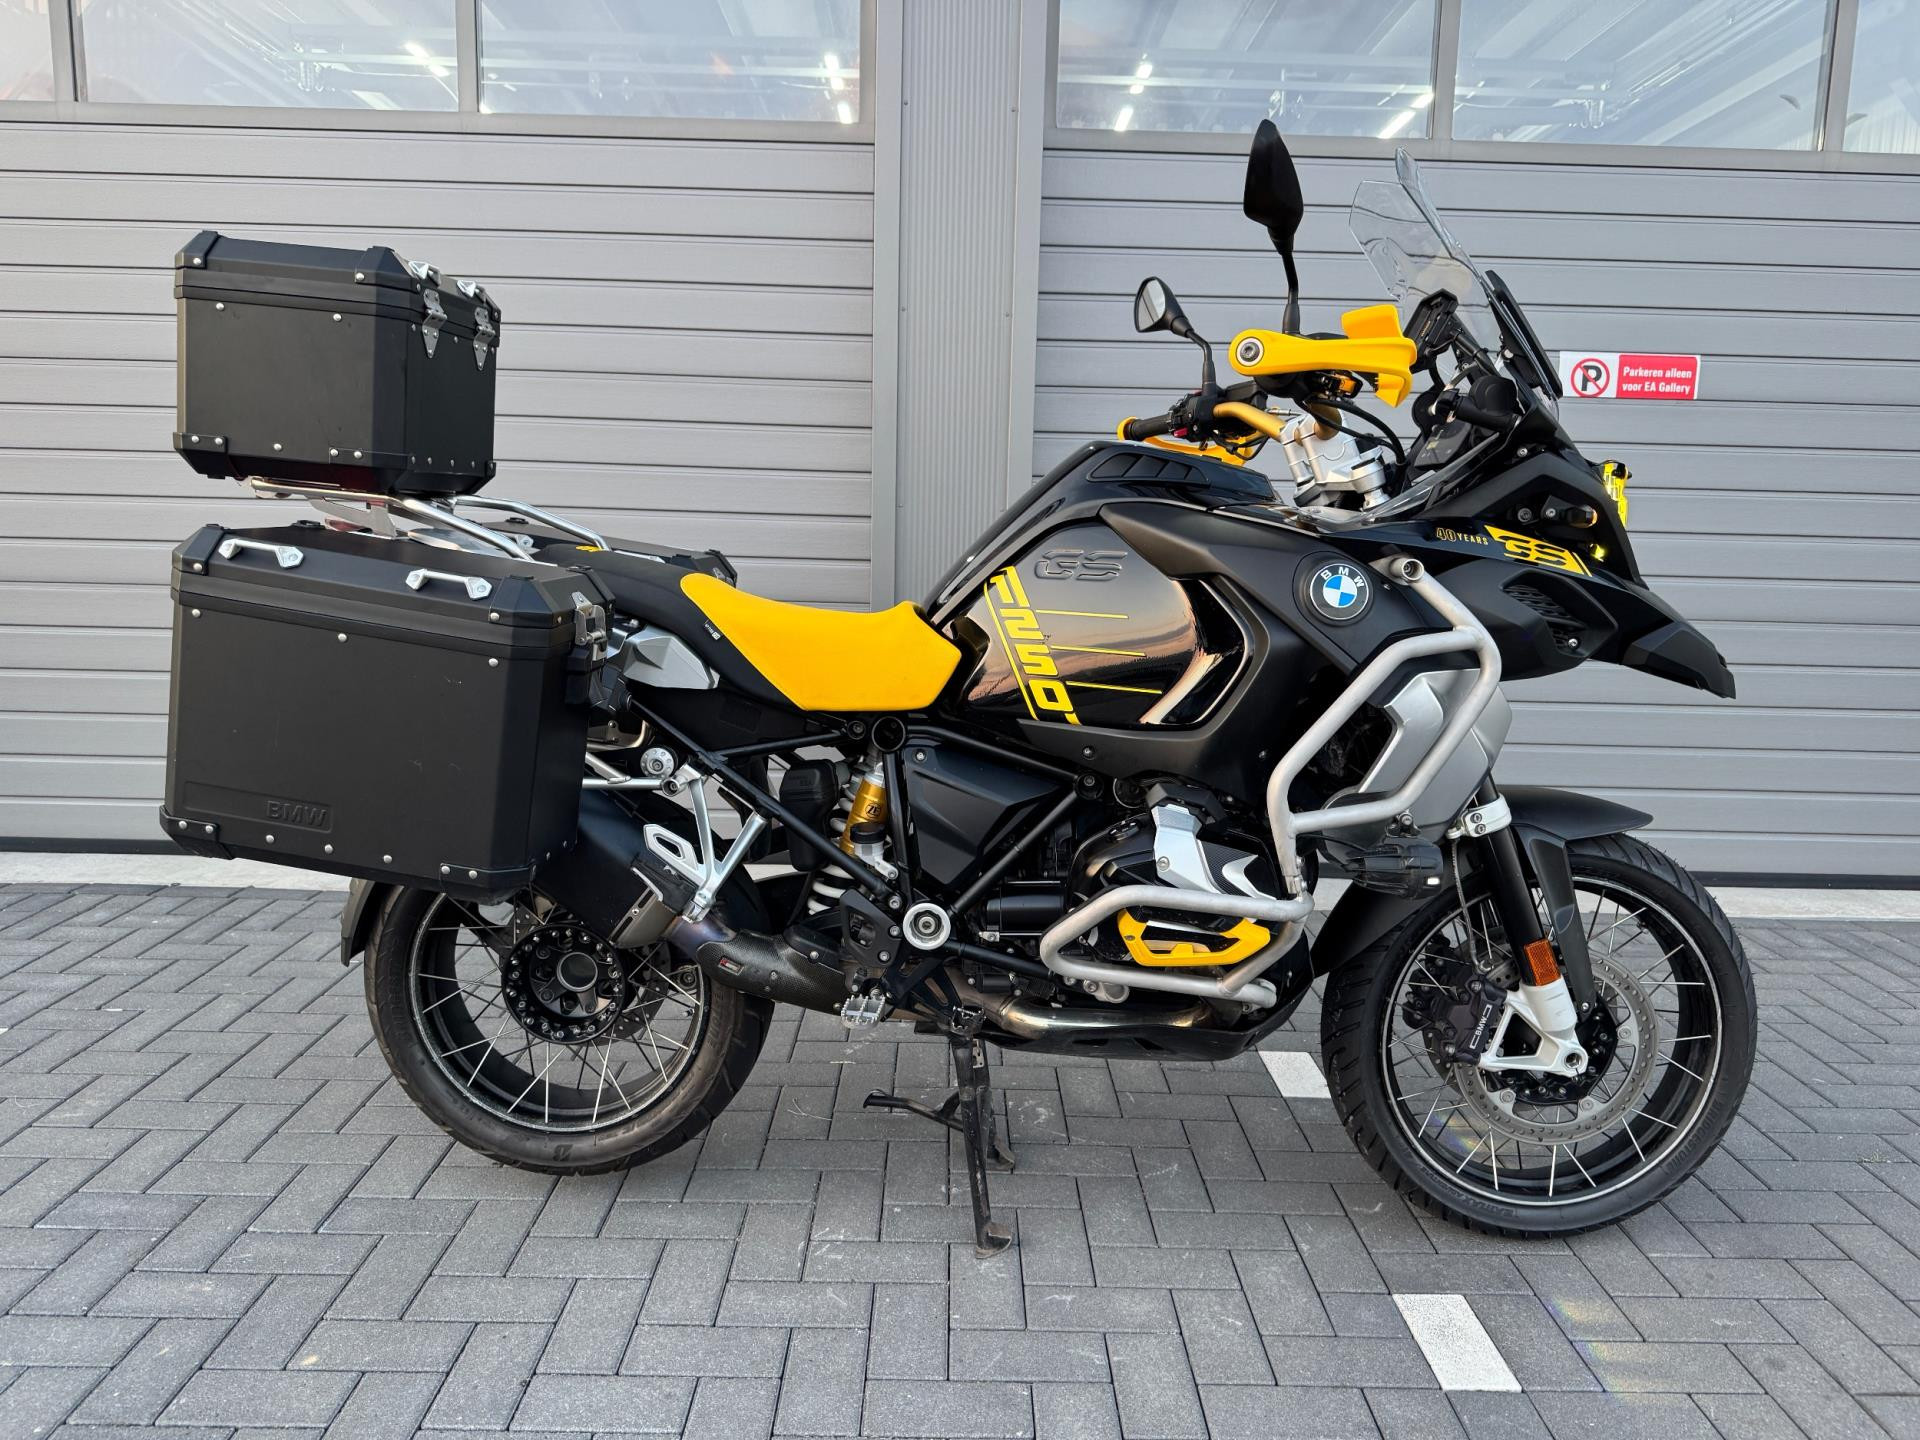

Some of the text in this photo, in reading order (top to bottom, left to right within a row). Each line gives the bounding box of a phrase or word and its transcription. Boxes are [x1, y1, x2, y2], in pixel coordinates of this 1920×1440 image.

[1623, 366, 1691, 378] Parkeren alleen
[1623, 382, 1690, 394] voor EA Gallery
[1436, 527, 1489, 546] 40 YEARS
[1033, 550, 1128, 581] GS
[1320, 566, 1365, 588] BMW
[989, 565, 1074, 713] 1250
[266, 800, 327, 828] BMW
[1474, 1015, 1488, 1037] BMW
